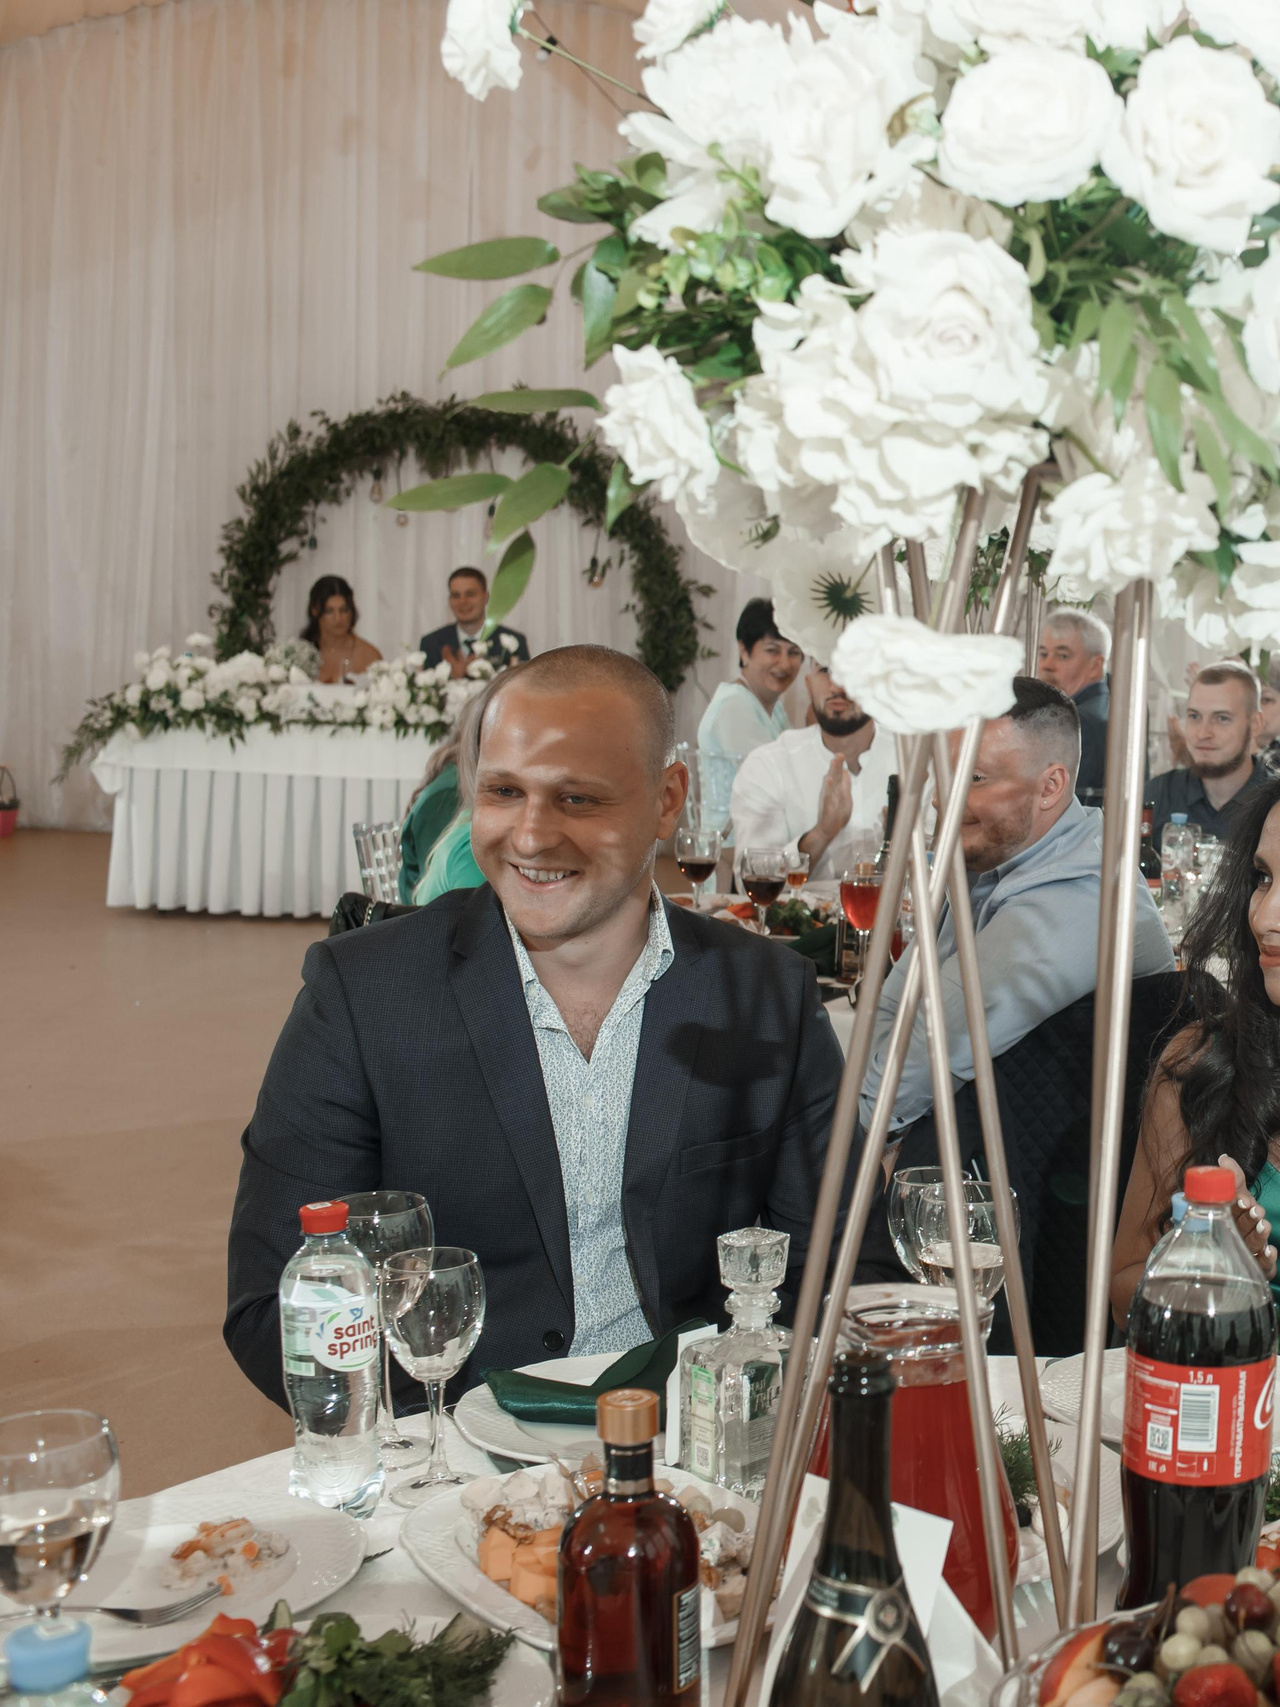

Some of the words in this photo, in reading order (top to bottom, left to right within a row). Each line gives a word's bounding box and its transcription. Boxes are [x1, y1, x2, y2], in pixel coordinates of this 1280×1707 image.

[333, 1315, 375, 1340] saint
[327, 1331, 378, 1360] spring
[1188, 1370, 1204, 1385] 1,5
[1205, 1373, 1214, 1384] л
[1233, 1370, 1247, 1478] ПЕРЕРАБАТЫВАЕМАЯ
